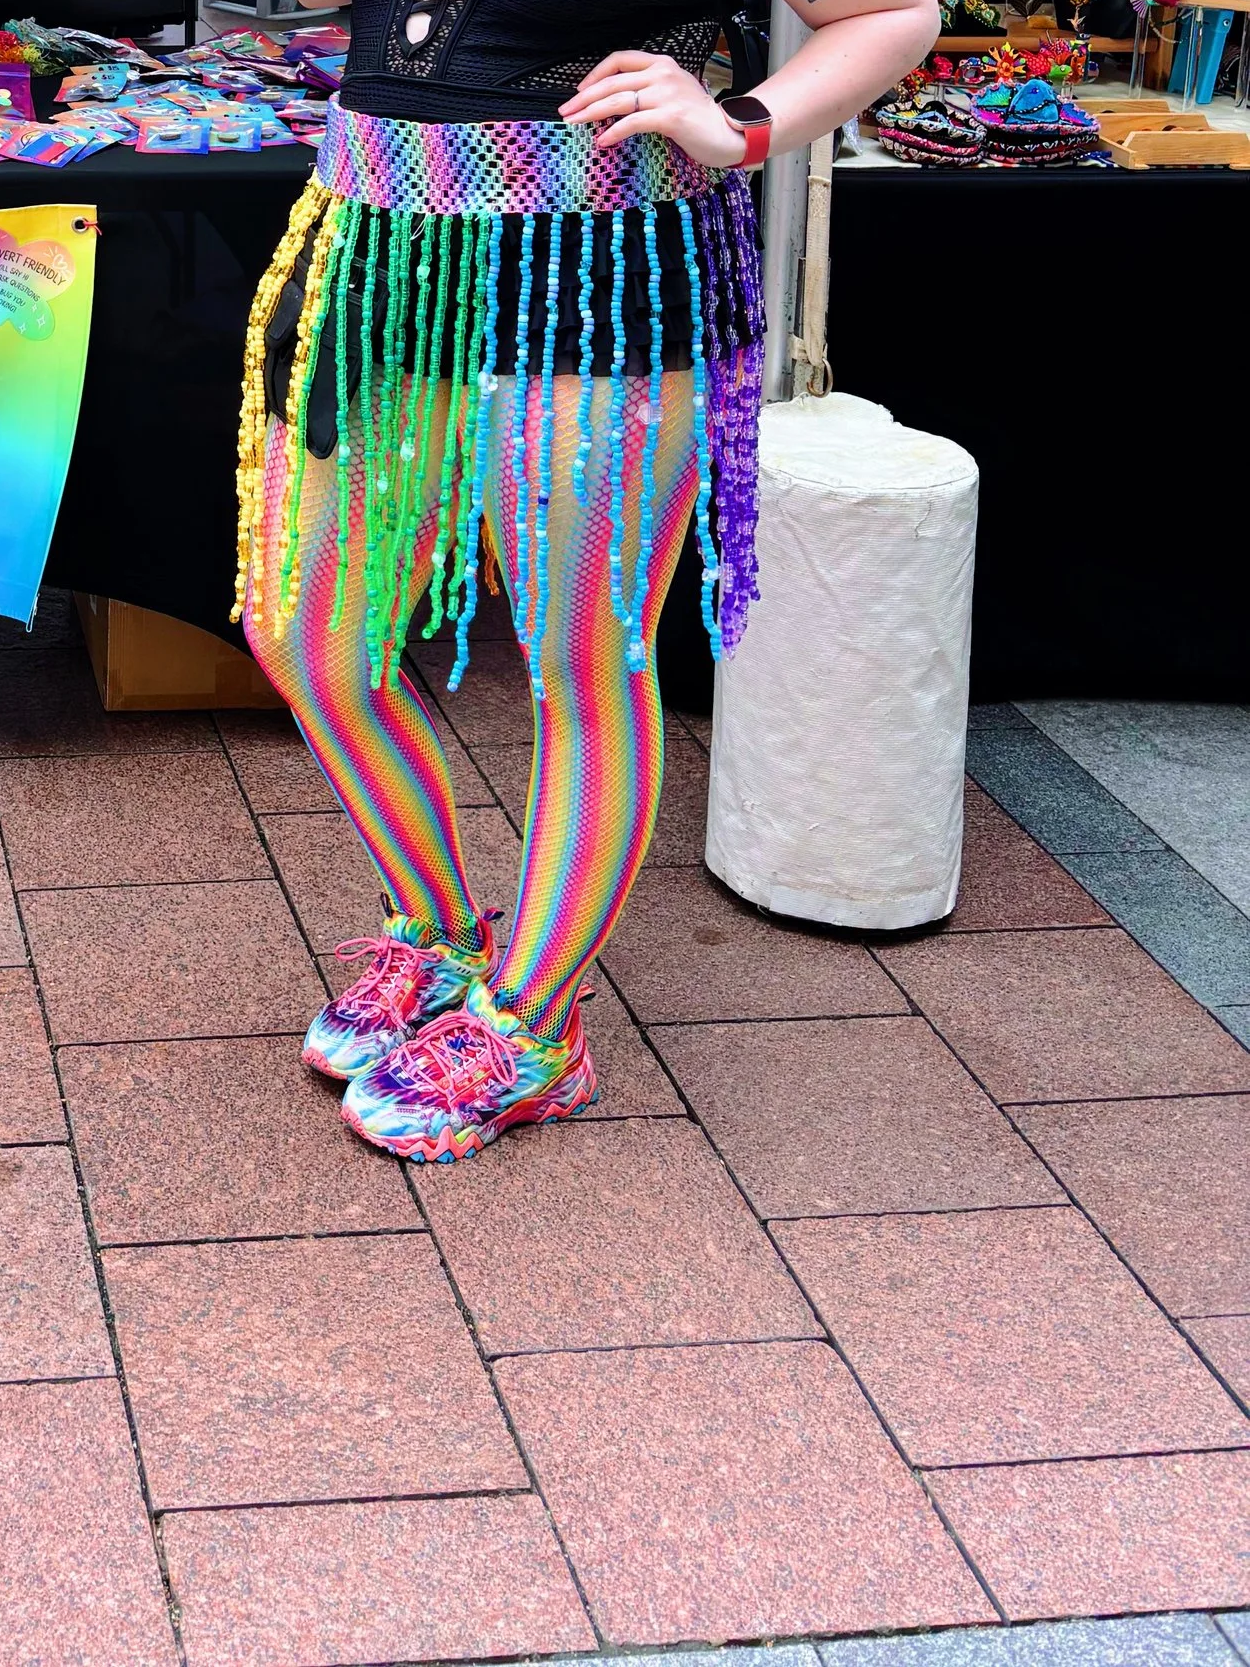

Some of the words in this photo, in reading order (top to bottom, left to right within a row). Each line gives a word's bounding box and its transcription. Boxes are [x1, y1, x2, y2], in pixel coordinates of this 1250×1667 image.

[10, 267, 22, 276] SAY
[22, 273, 30, 281] HI
[22, 256, 66, 287] FRIENDLY
[0, 288, 13, 299] BUG
[13, 295, 26, 307] YOU
[9, 278, 41, 302] QUESTIONS
[473, 1078, 495, 1096] FILA
